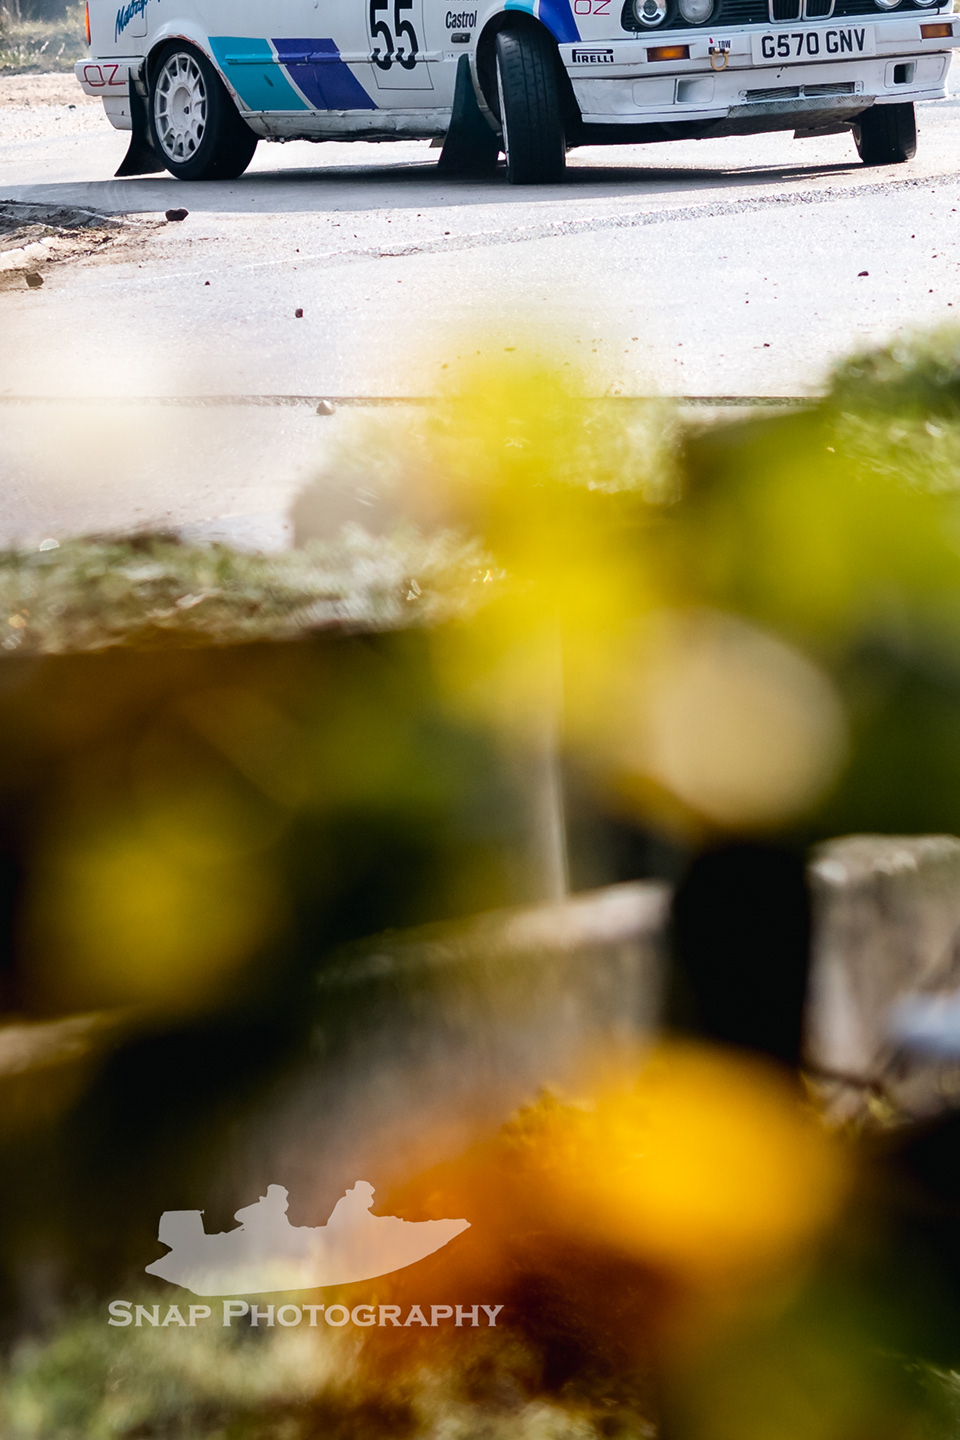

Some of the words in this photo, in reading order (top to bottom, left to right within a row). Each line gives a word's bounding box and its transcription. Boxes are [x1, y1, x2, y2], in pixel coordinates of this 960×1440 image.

[445, 10, 477, 29] Castrol
[825, 28, 866, 54] GNV
[572, 49, 614, 63] PIRELLI
[83, 64, 126, 87] OZ
